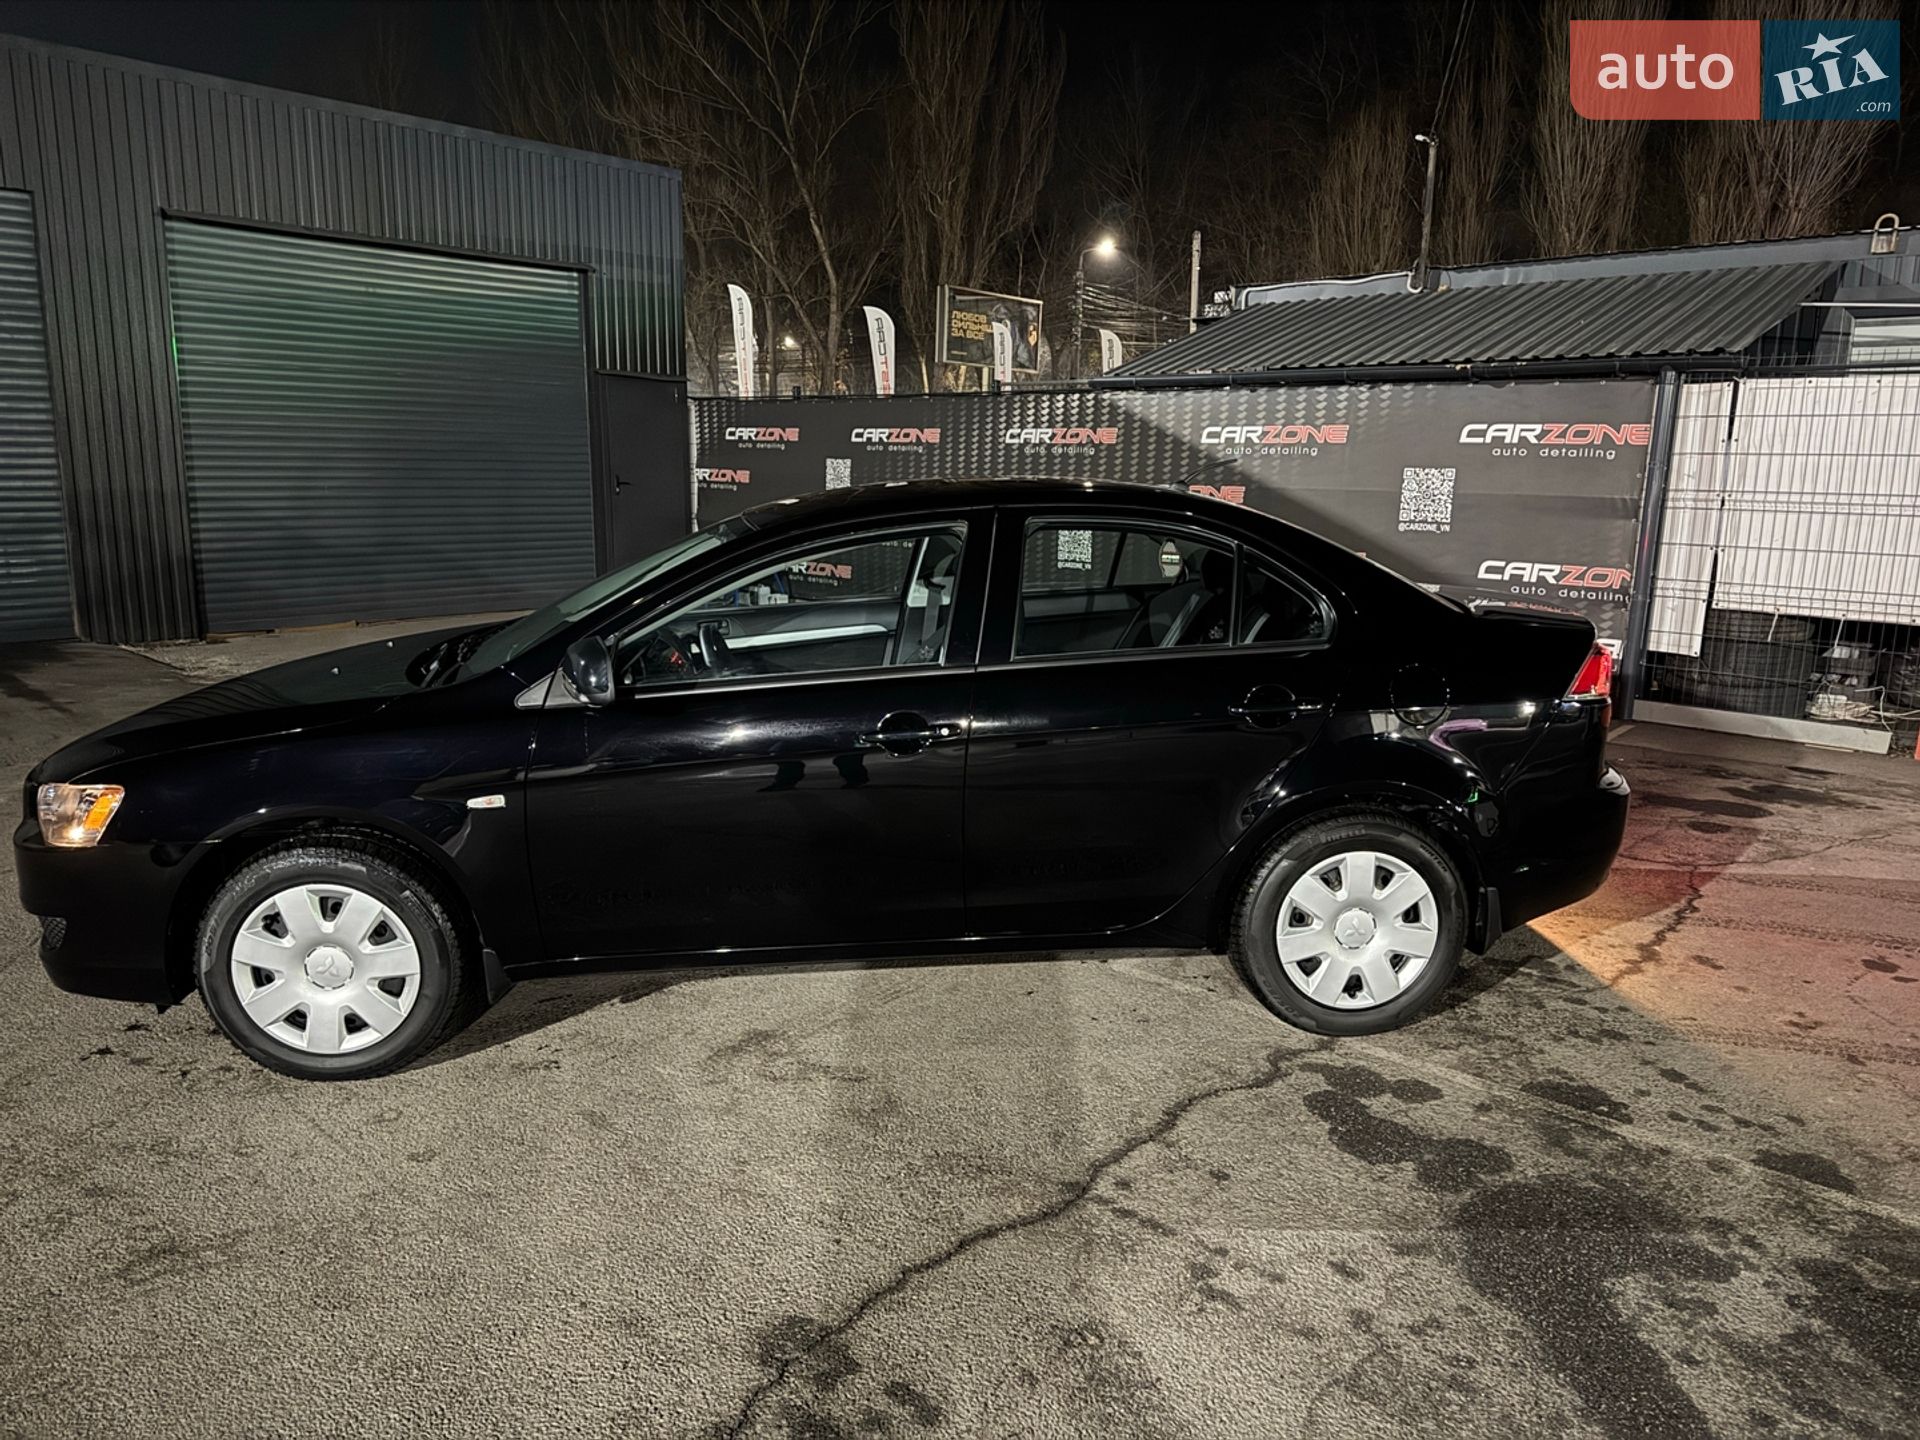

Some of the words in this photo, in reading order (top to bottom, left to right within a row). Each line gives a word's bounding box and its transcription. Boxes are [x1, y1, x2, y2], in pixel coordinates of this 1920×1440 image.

[951, 319, 994, 333] СИЛЬНІШ
[951, 328, 965, 338] ЗА
[966, 330, 985, 340] ВСЕ
[725, 427, 800, 441] CARZONE
[850, 428, 942, 444] CARZONE
[1005, 427, 1118, 444] CARZONE
[1200, 424, 1350, 444] CARZONE
[1459, 423, 1651, 445] CARZONE
[756, 442, 785, 450] detailing
[888, 444, 924, 452] detailing
[1024, 446, 1045, 454] auto
[1051, 446, 1095, 455] detailing
[1225, 447, 1252, 455] auto
[1261, 447, 1318, 456] detailing
[1492, 447, 1528, 456] auto
[1539, 447, 1616, 460] detailing
[694, 468, 750, 483] ARZONE
[1477, 560, 1632, 589] CARZON
[1510, 585, 1546, 596] auto
